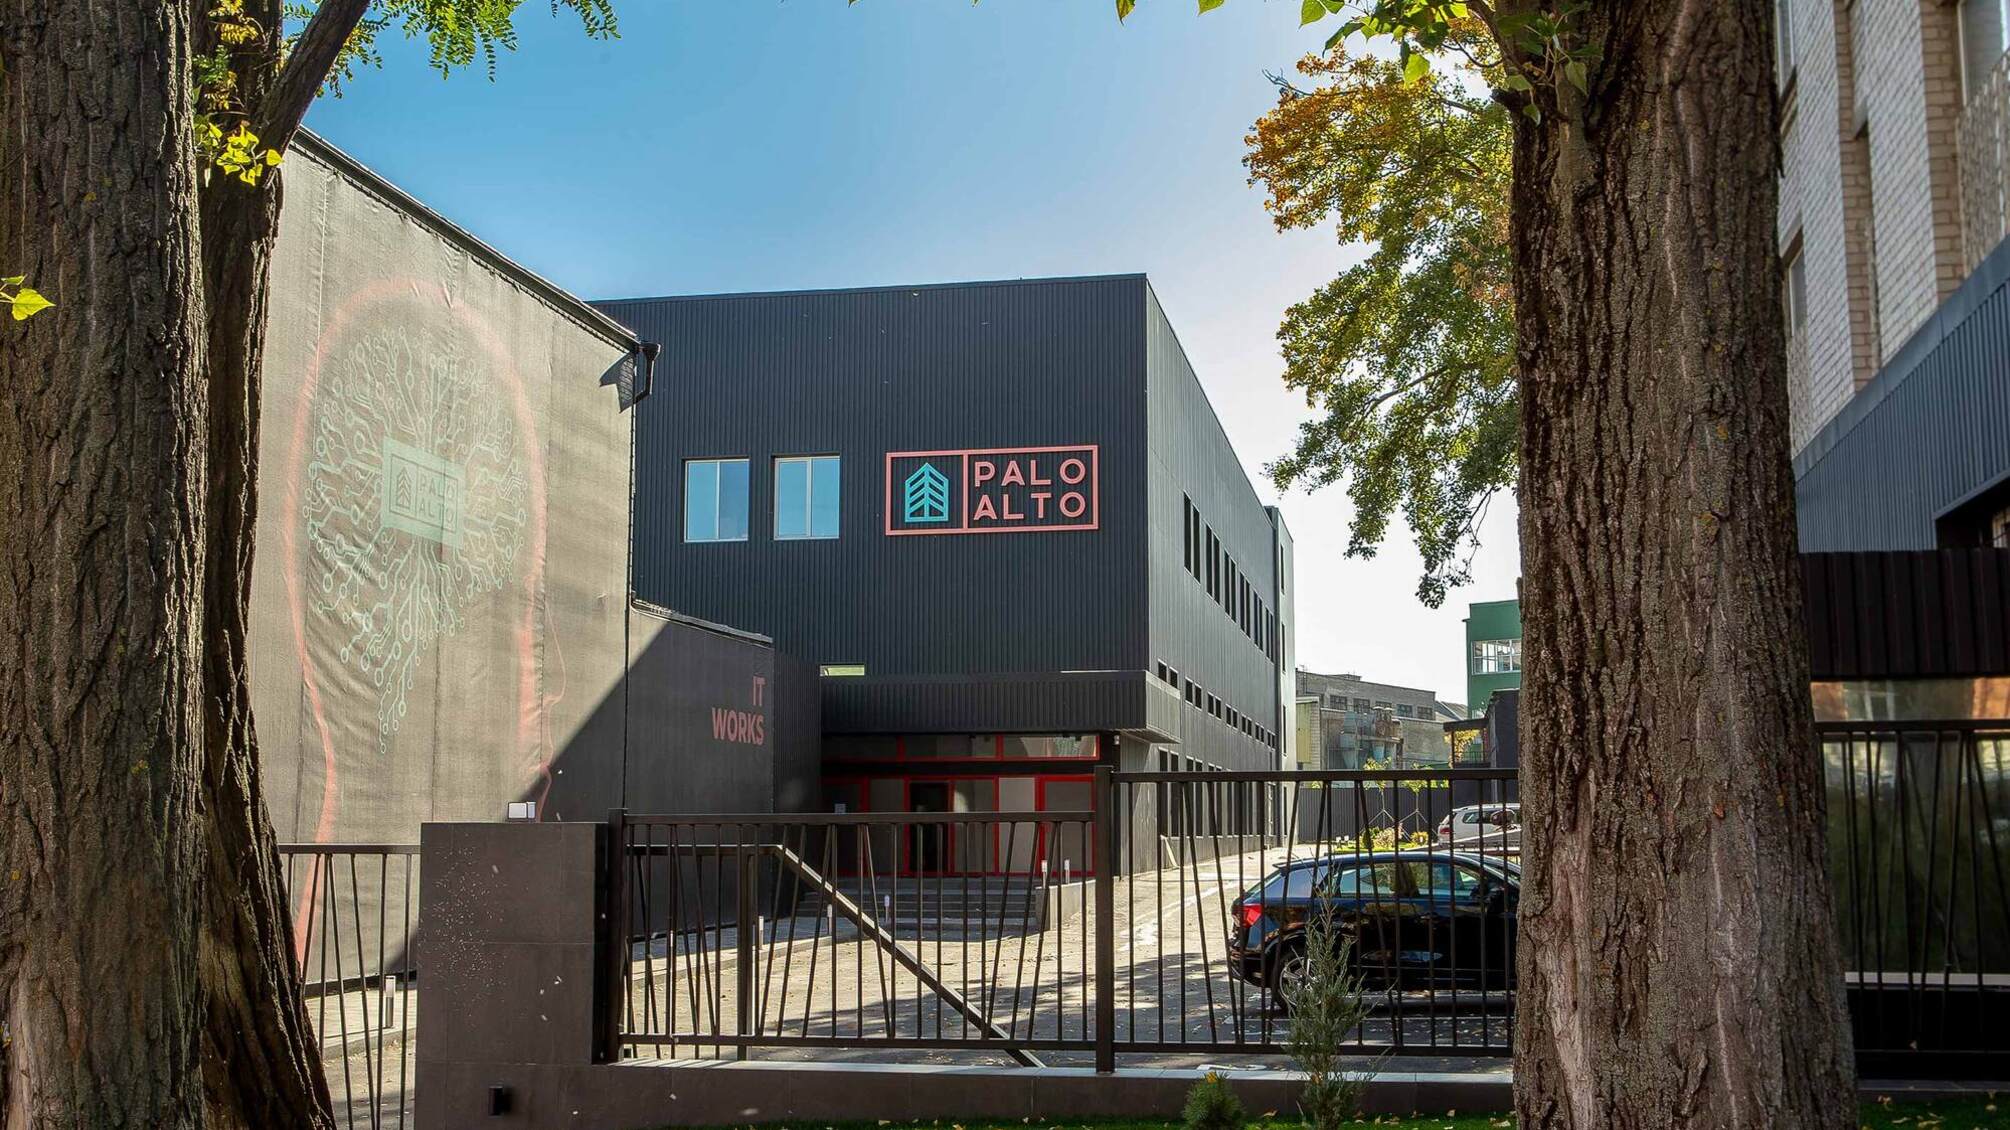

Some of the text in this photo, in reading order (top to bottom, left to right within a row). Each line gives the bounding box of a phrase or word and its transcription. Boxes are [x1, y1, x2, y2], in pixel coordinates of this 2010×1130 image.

[419, 473, 457, 499] PALO
[974, 458, 1086, 487] PALO
[419, 497, 457, 525] ALTO
[973, 491, 1086, 520] ALTO
[752, 676, 766, 706] IT
[711, 707, 764, 745] WORKS
